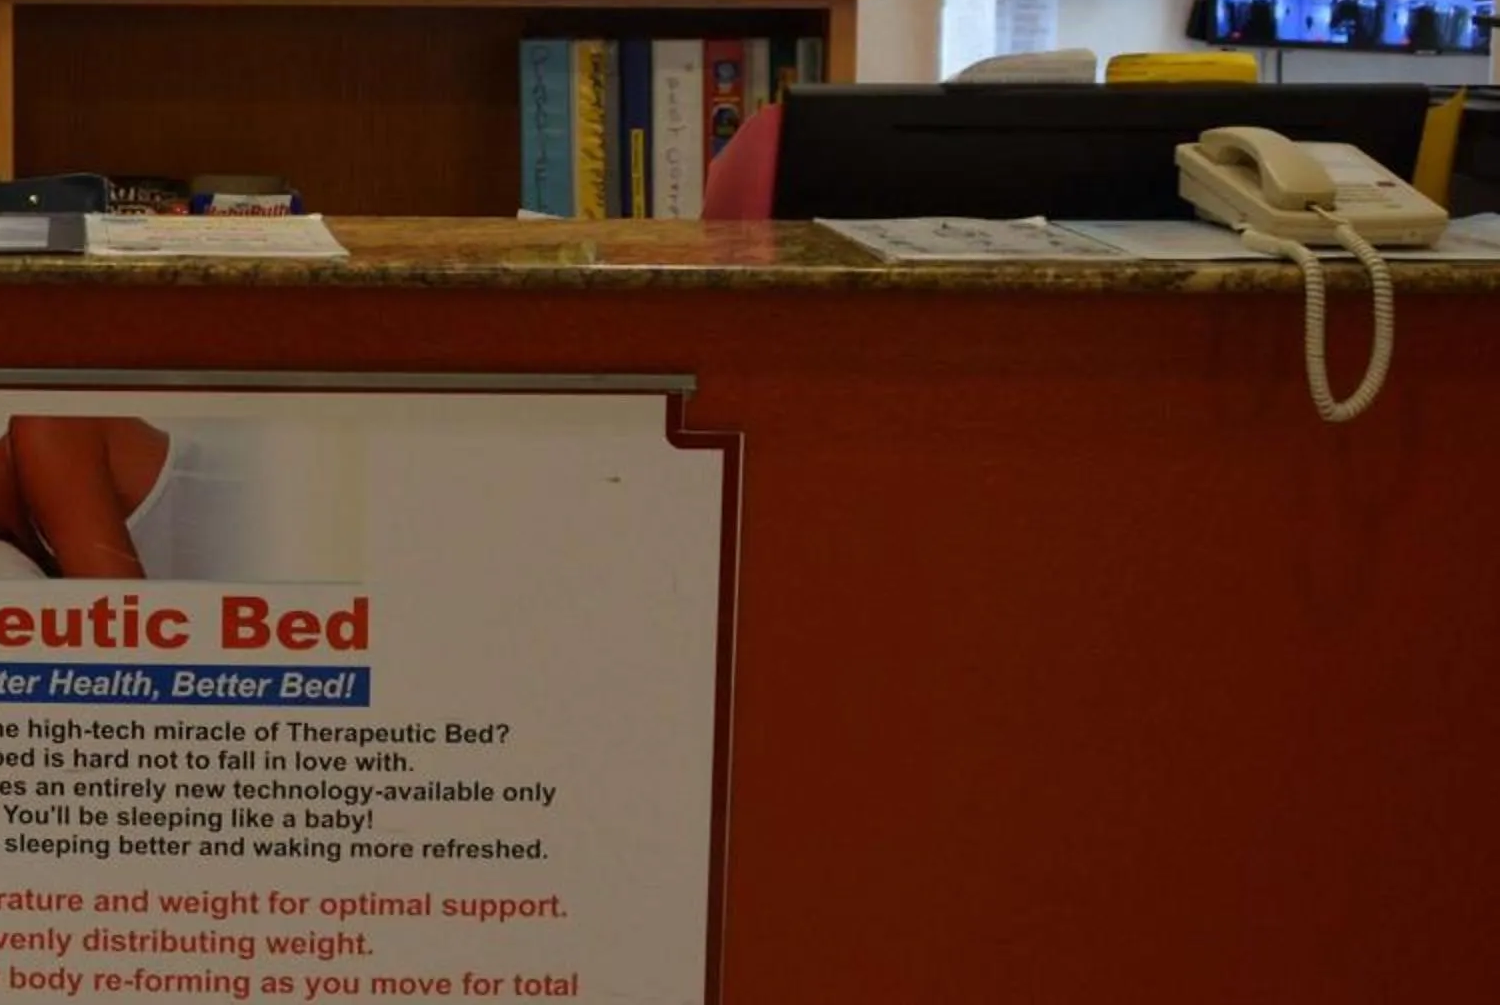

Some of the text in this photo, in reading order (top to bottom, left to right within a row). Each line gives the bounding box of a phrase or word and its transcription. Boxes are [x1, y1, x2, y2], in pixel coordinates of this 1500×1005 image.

[221, 596, 370, 651] Bed
[48, 669, 159, 701] Health,
[170, 669, 272, 699] Better
[279, 672, 356, 699] Bed!
[27, 718, 145, 744] high-tech
[154, 720, 246, 742] miracle
[254, 721, 280, 742] of
[286, 722, 437, 748] Therapeutic
[445, 723, 510, 744] Bed?
[44, 747, 65, 768] is
[73, 748, 129, 769] hard
[138, 750, 178, 770] not
[185, 750, 211, 770] to
[218, 749, 255, 771] fall
[264, 750, 287, 771] in
[295, 751, 347, 772] love
[355, 751, 414, 772] with.
[35, 781, 65, 797] an
[73, 777, 167, 804] entirely
[175, 783, 226, 799] new
[233, 779, 495, 806] technology-available
[502, 782, 557, 807] only
[3, 804, 70, 826] You'll
[79, 805, 109, 826] be
[116, 807, 223, 833] sleeping
[231, 807, 275, 828] like
[282, 813, 296, 828] a
[305, 808, 373, 835] baby!
[4, 833, 110, 860] sleeping
[119, 834, 193, 857] better
[199, 835, 246, 858] and
[253, 837, 341, 863] waking
[350, 840, 414, 858] more
[422, 838, 548, 860] refreshed.
[93, 889, 149, 913] and
[158, 890, 259, 921] weight
[268, 890, 311, 916] for
[319, 891, 431, 922] optimal
[441, 894, 567, 924] support.
[82, 927, 256, 961] distributing
[265, 930, 374, 962] weight.
[9, 965, 84, 996] body
[94, 967, 251, 999] re-forming
[260, 975, 295, 994] as
[305, 976, 360, 1000] you
[370, 977, 452, 996] move
[461, 971, 505, 996] for
[513, 972, 579, 997] total
